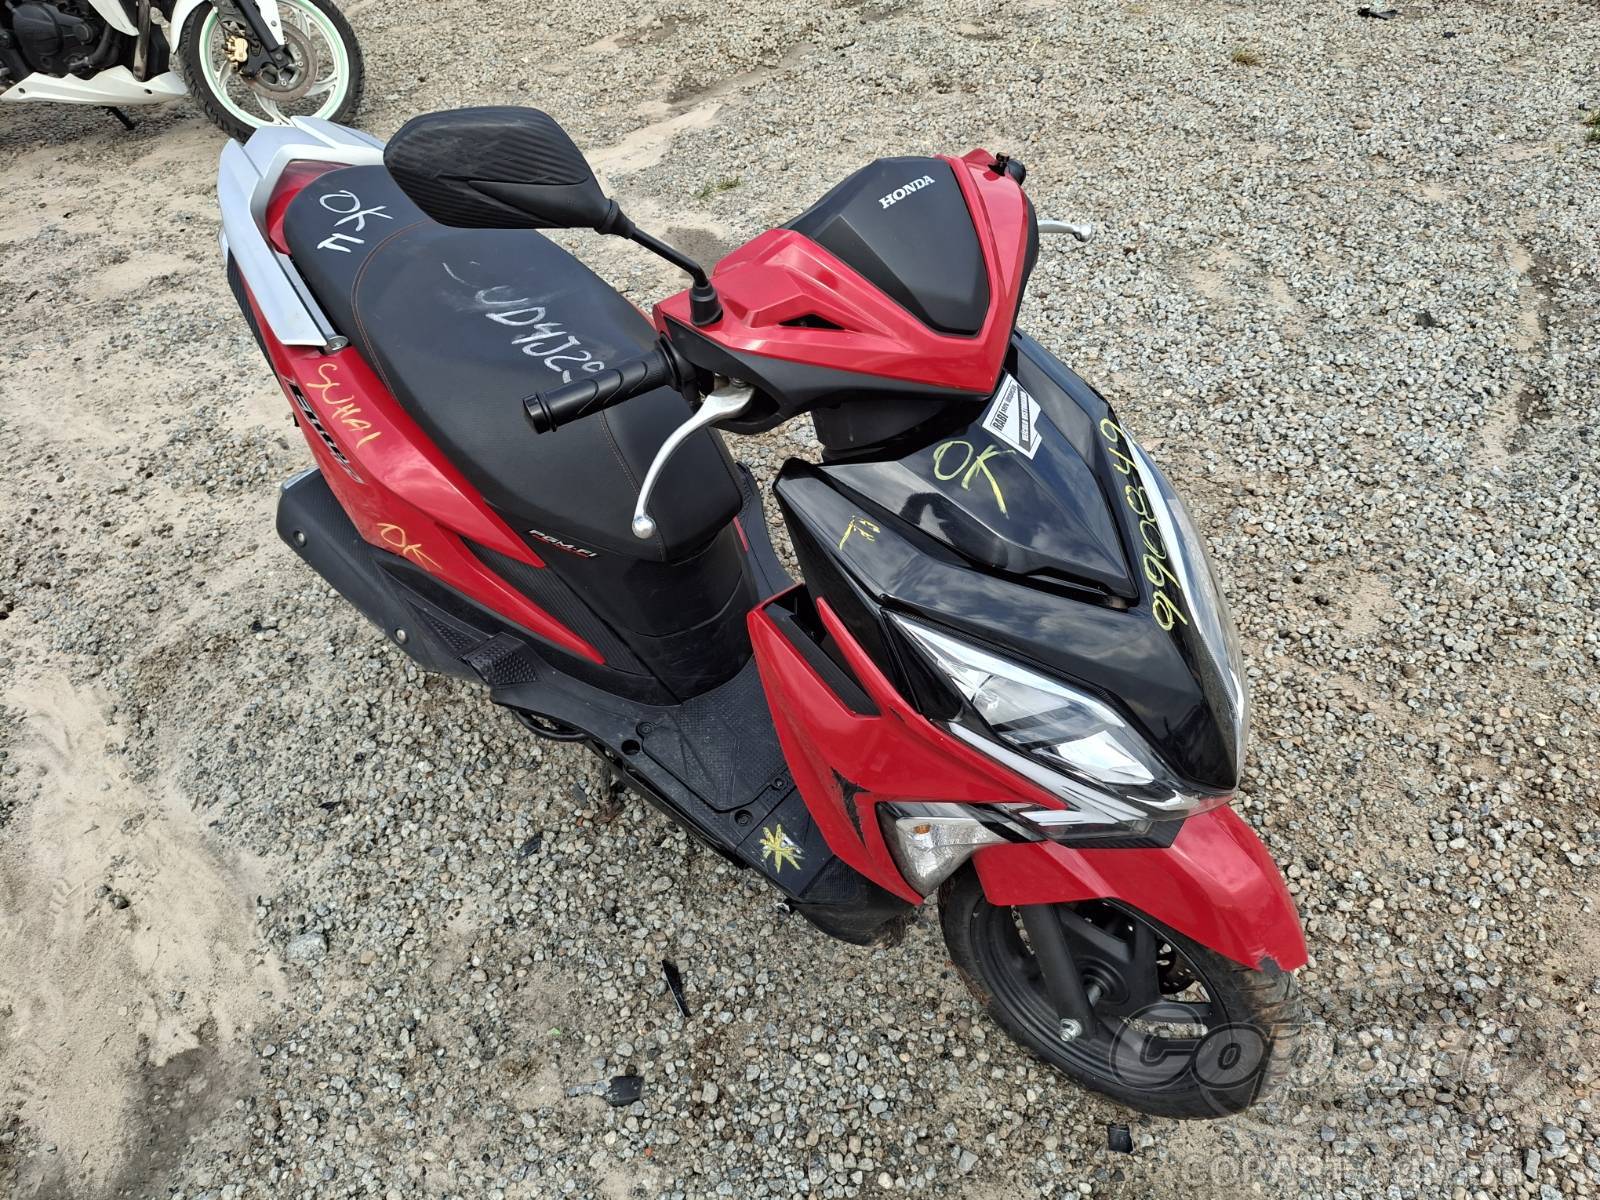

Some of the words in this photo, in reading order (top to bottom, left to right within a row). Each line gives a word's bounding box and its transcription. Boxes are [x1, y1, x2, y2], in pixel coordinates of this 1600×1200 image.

[319, 189, 394, 232] OK
[878, 175, 936, 209] HONDA
[933, 440, 1017, 520] OK
[376, 522, 443, 572] OK
